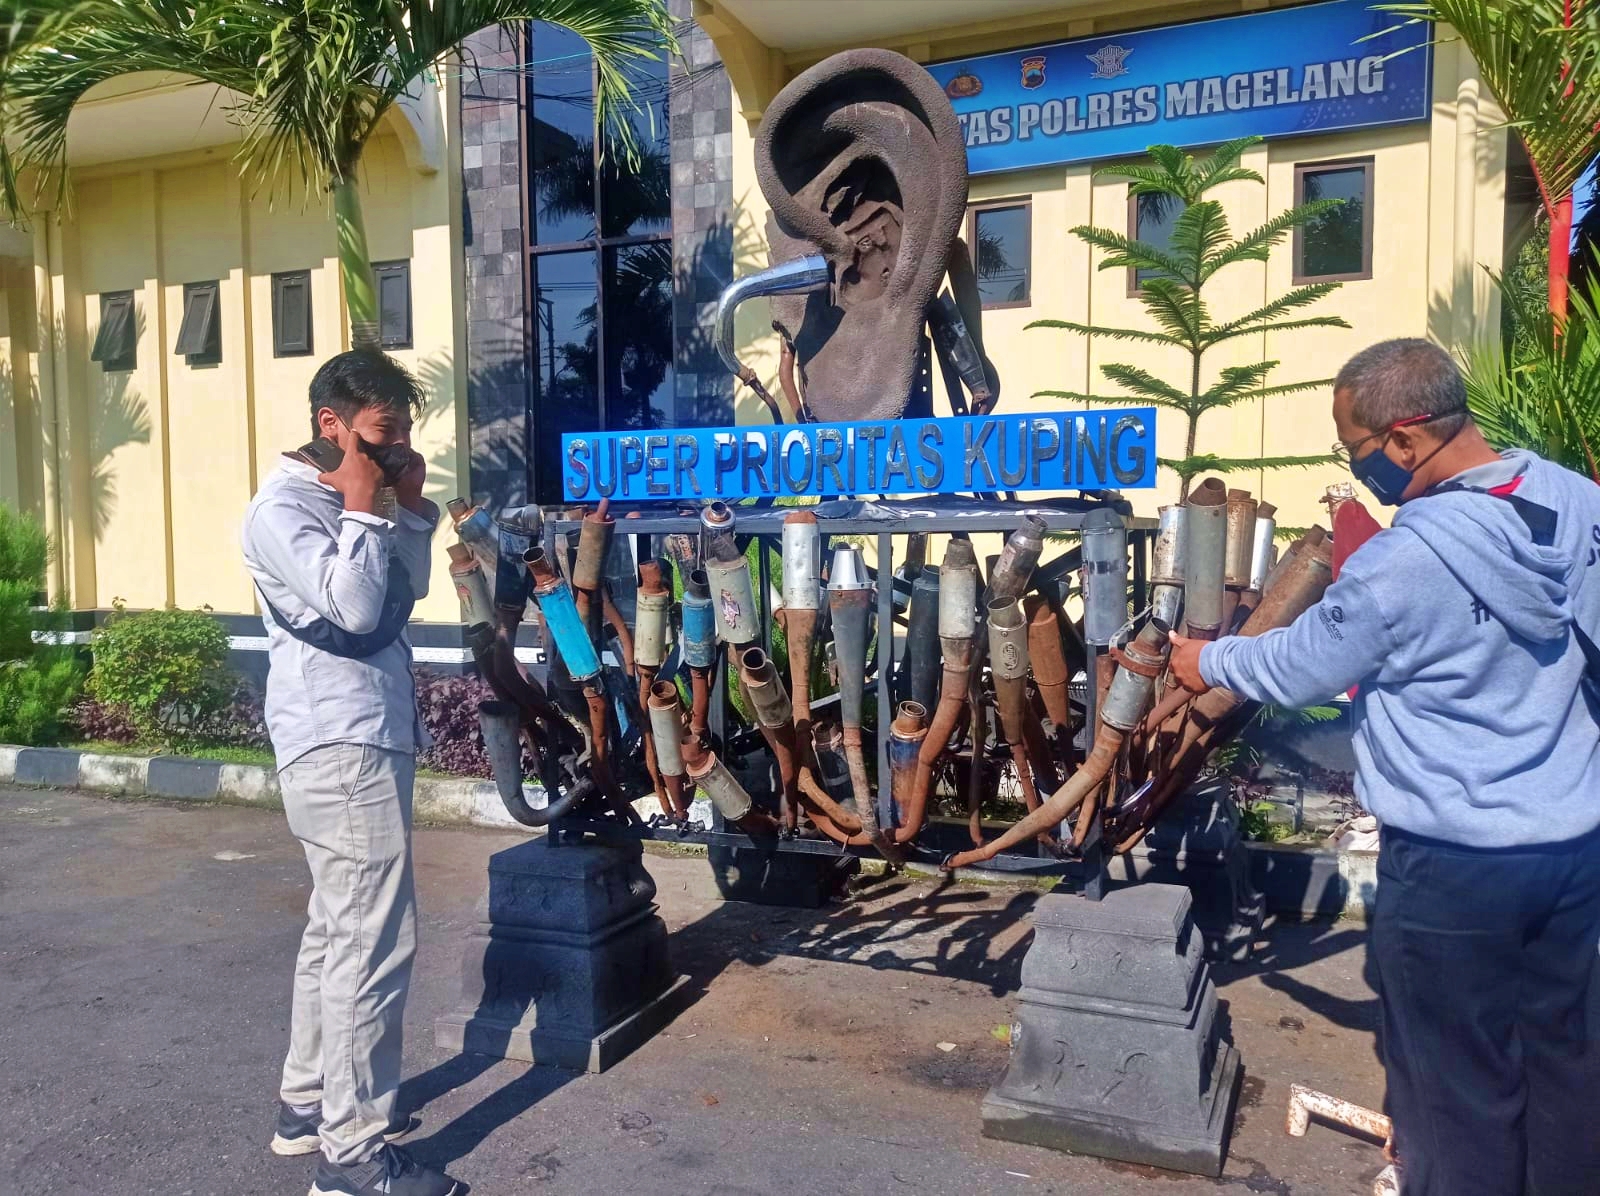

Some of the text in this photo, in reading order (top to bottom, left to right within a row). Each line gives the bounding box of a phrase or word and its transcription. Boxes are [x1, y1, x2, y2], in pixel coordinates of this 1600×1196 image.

[1018, 87, 1158, 139] POLRES
[1166, 55, 1384, 119] MAGELANG
[566, 414, 1147, 499] SUPER PRIORITAS KUPING
